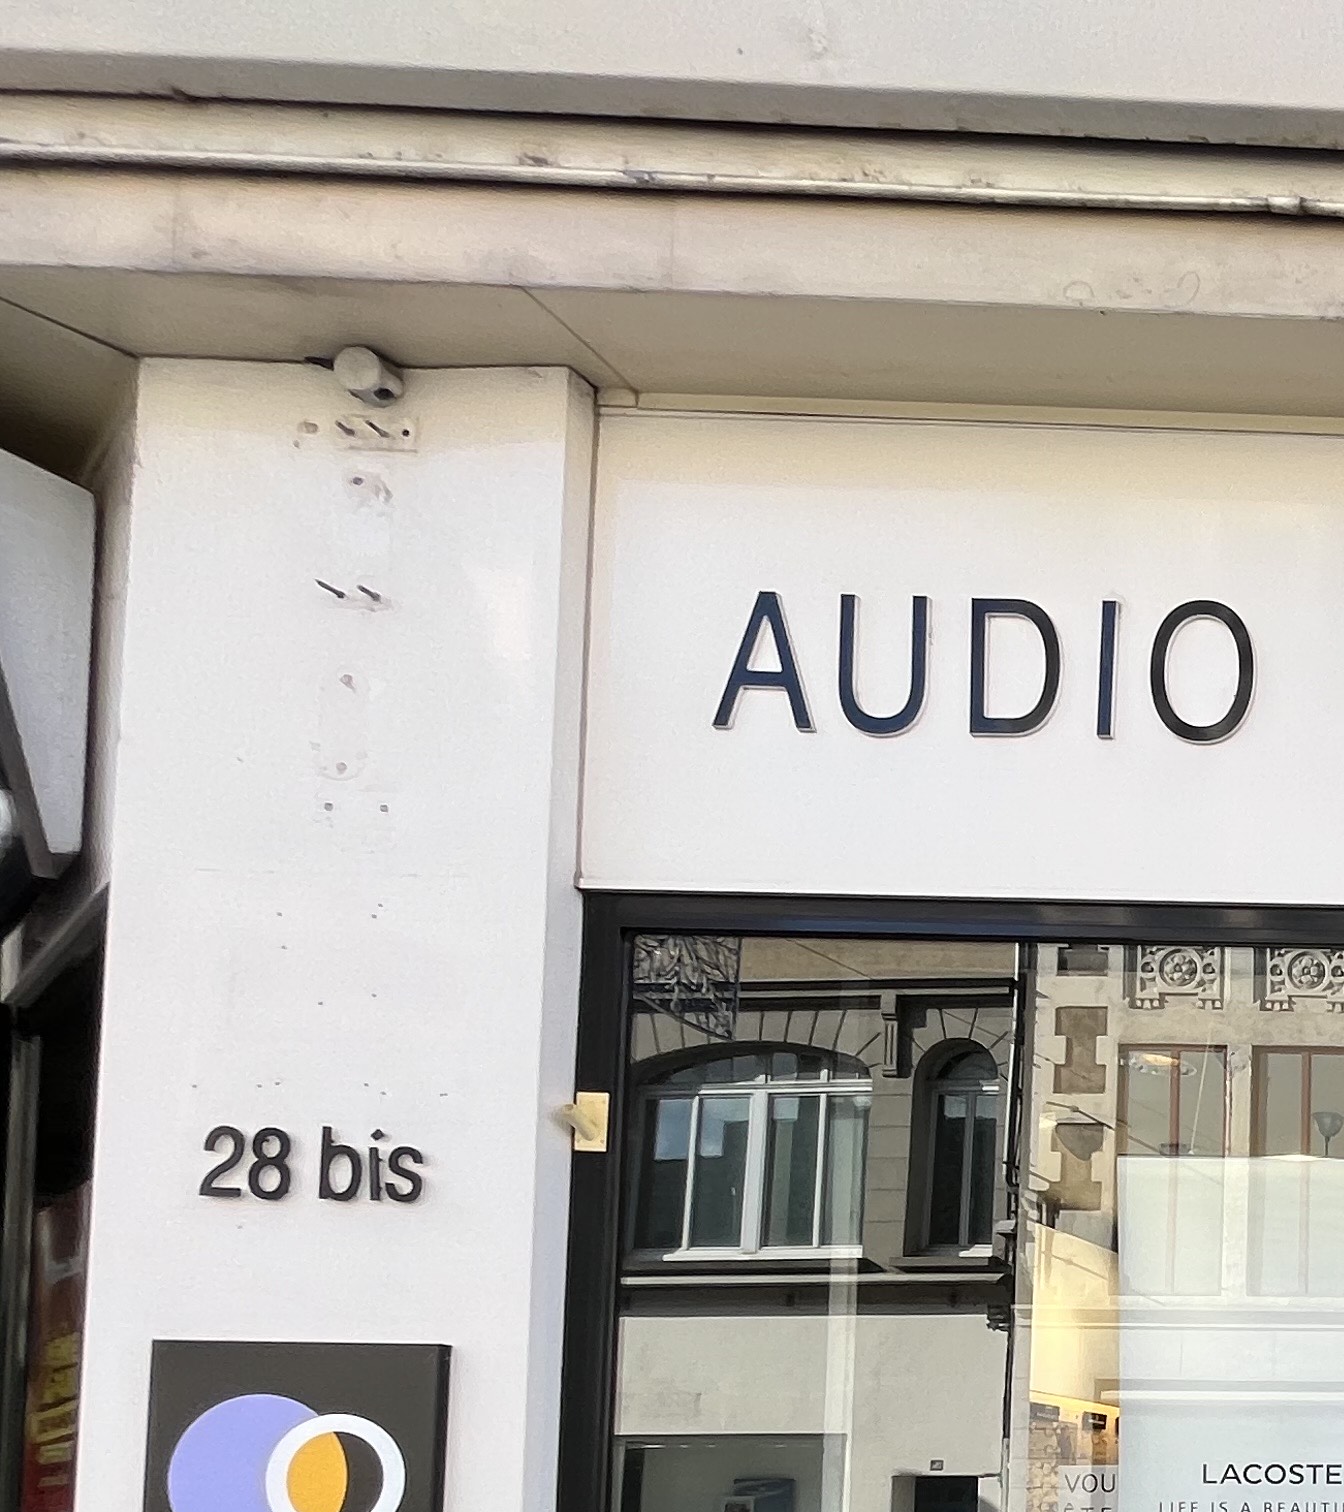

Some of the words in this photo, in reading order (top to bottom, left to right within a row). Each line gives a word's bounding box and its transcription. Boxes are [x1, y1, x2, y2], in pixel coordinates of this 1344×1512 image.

[712, 591, 1255, 745] AUDIO
[198, 1125, 291, 1201] 28
[318, 1125, 424, 1202] bis
[1202, 1463, 1343, 1485] LACOSTE
